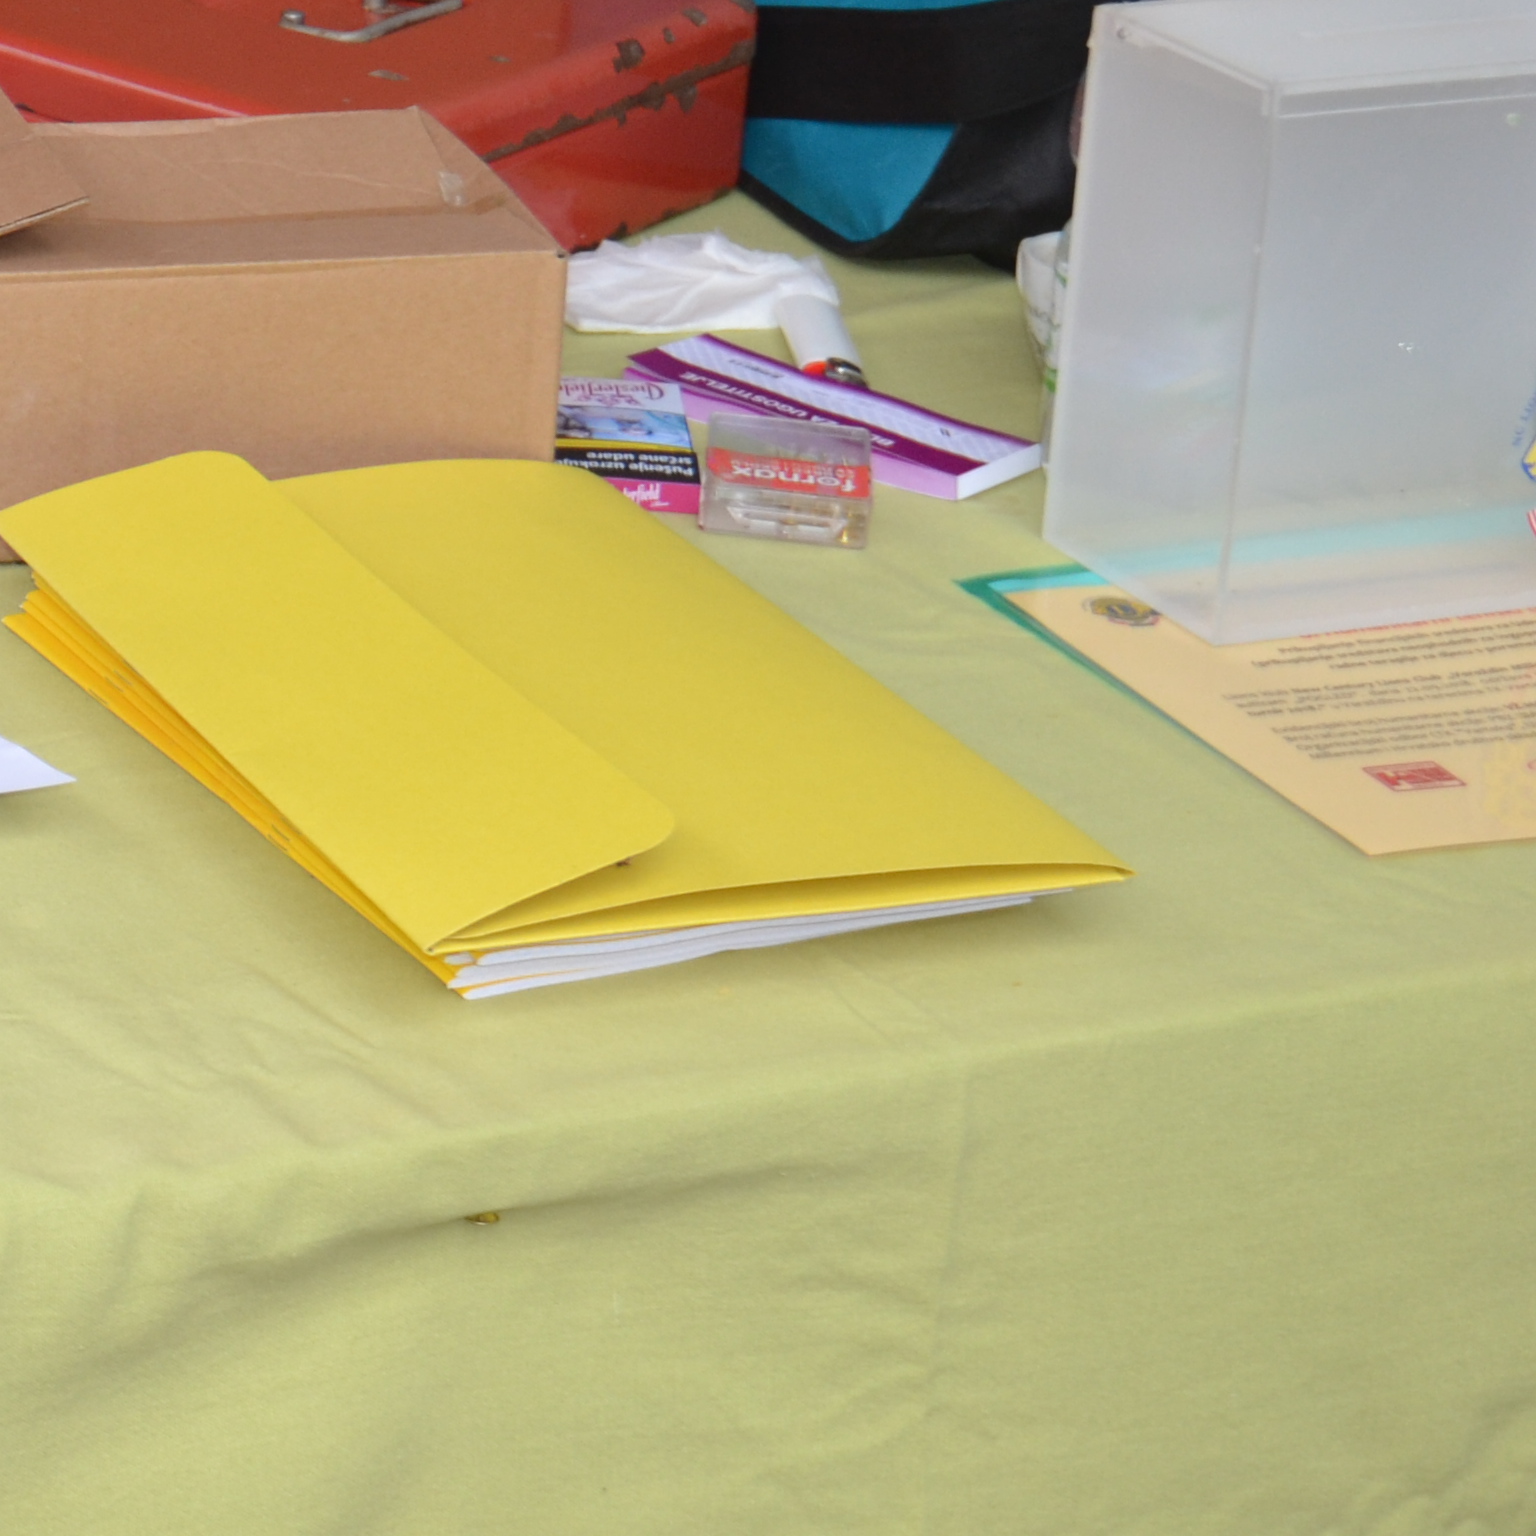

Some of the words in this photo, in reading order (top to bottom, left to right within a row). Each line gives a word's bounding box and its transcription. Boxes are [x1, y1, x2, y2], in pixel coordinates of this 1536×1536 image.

[679, 371, 807, 419] UGOSTITELJE
[586, 451, 635, 462] udare
[638, 453, 694, 466] srčane
[628, 462, 695, 477] Pušenje
[731, 464, 856, 493] fornax
